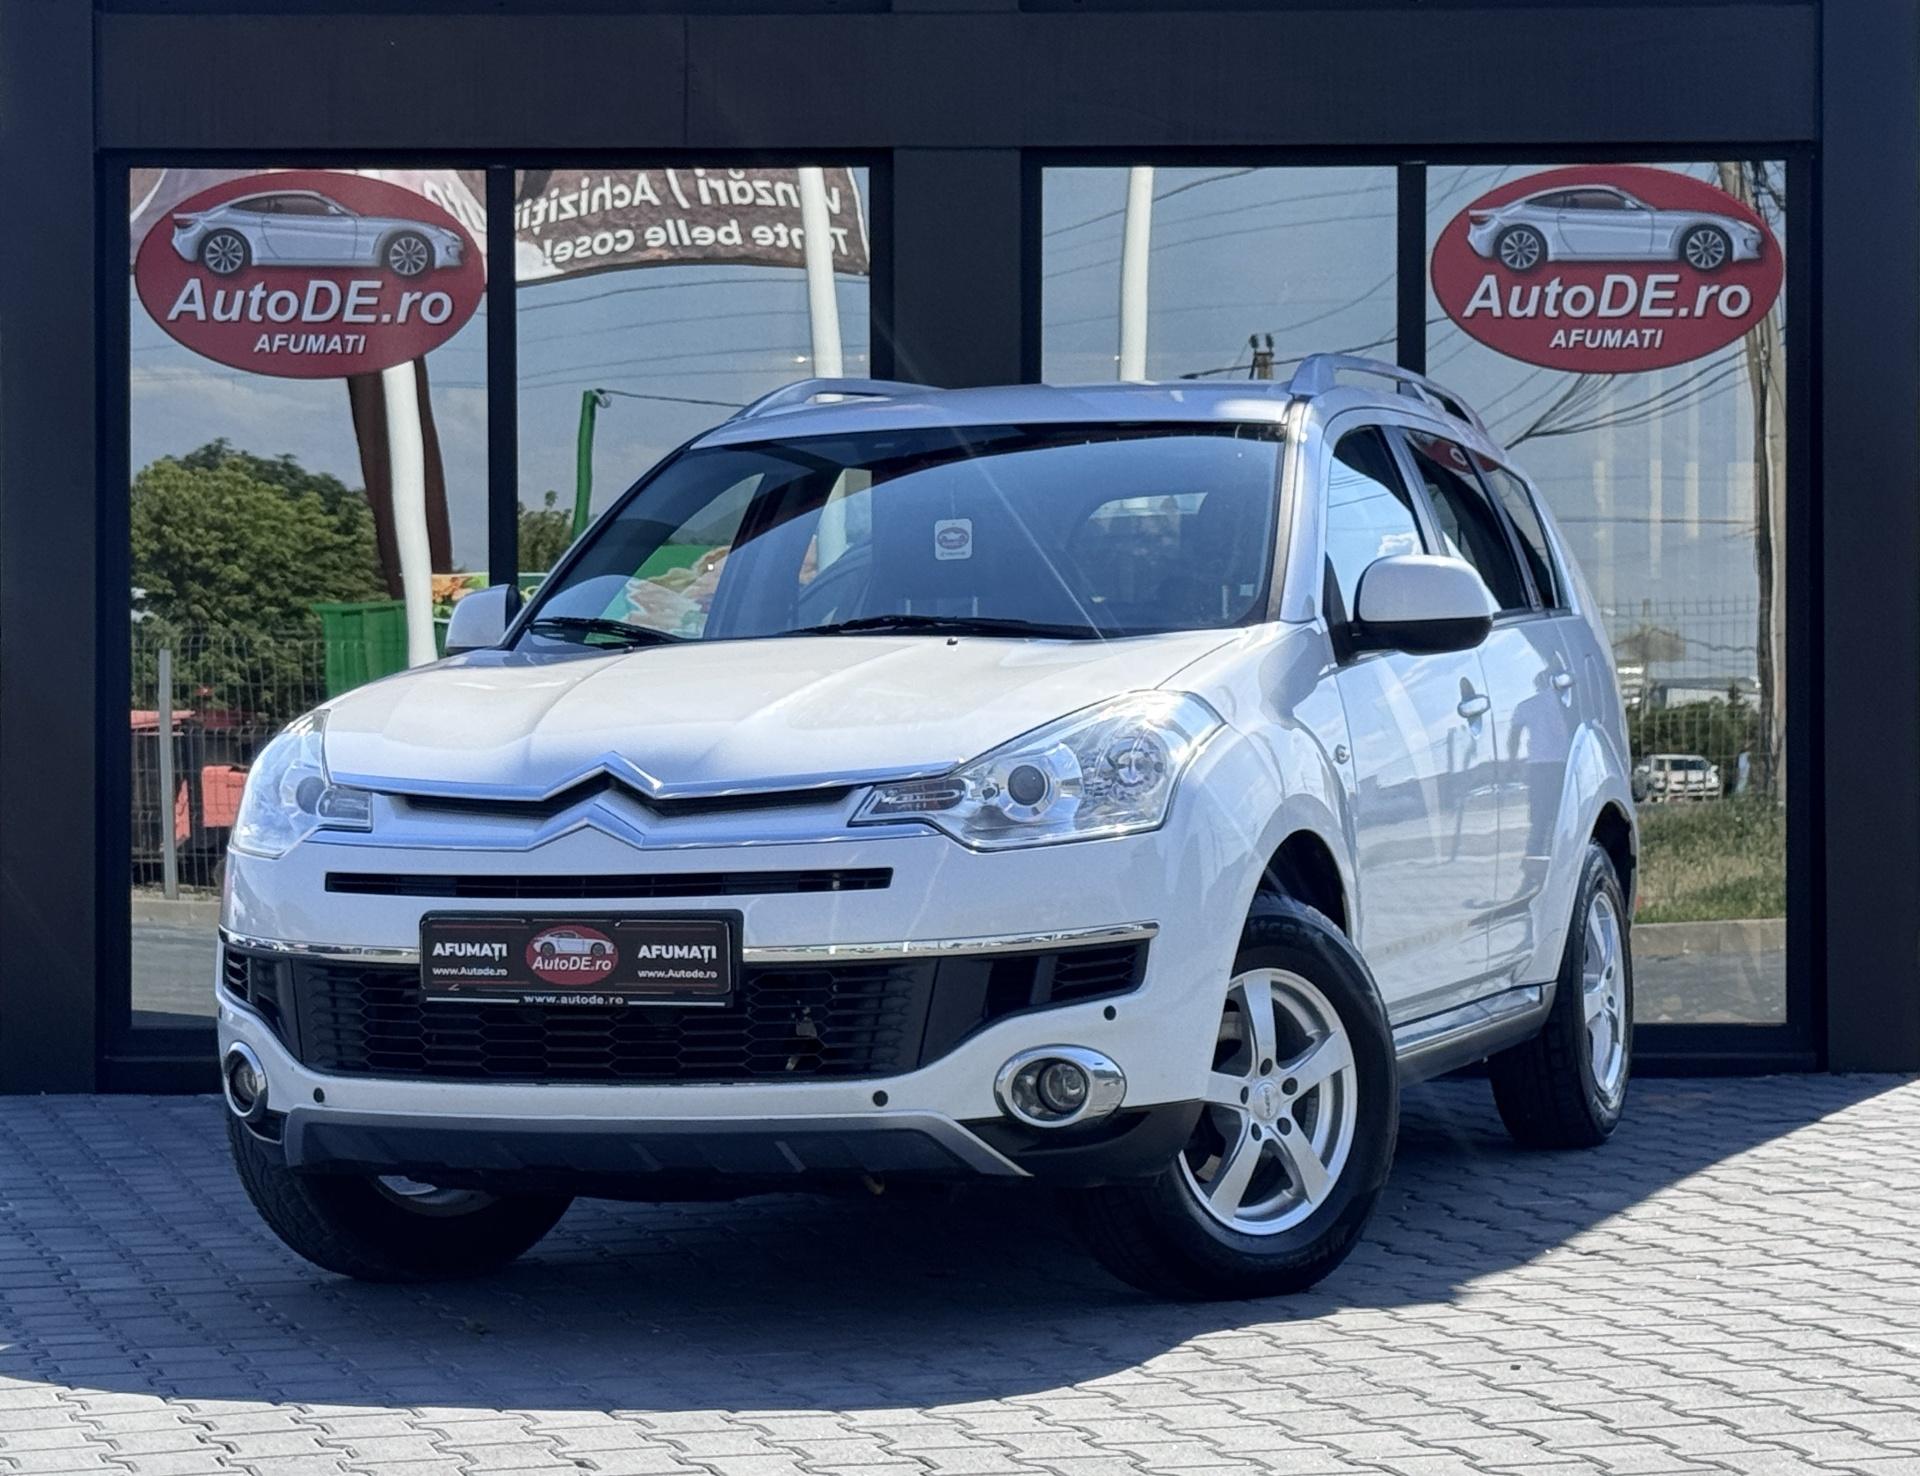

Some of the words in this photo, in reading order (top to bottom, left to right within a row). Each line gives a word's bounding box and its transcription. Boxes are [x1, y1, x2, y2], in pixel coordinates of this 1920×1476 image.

[167, 278, 454, 324] AutoDE.ro
[1462, 274, 1751, 318] AutoDE.ro
[253, 334, 367, 354] AFUMATI
[1549, 328, 1663, 349] AFUMATI
[432, 966, 508, 976] www.Autode.ro
[532, 956, 612, 971] AutoDE.ro
[637, 969, 718, 979] www.Autode.ro
[523, 995, 624, 1005] www.autode.ro
